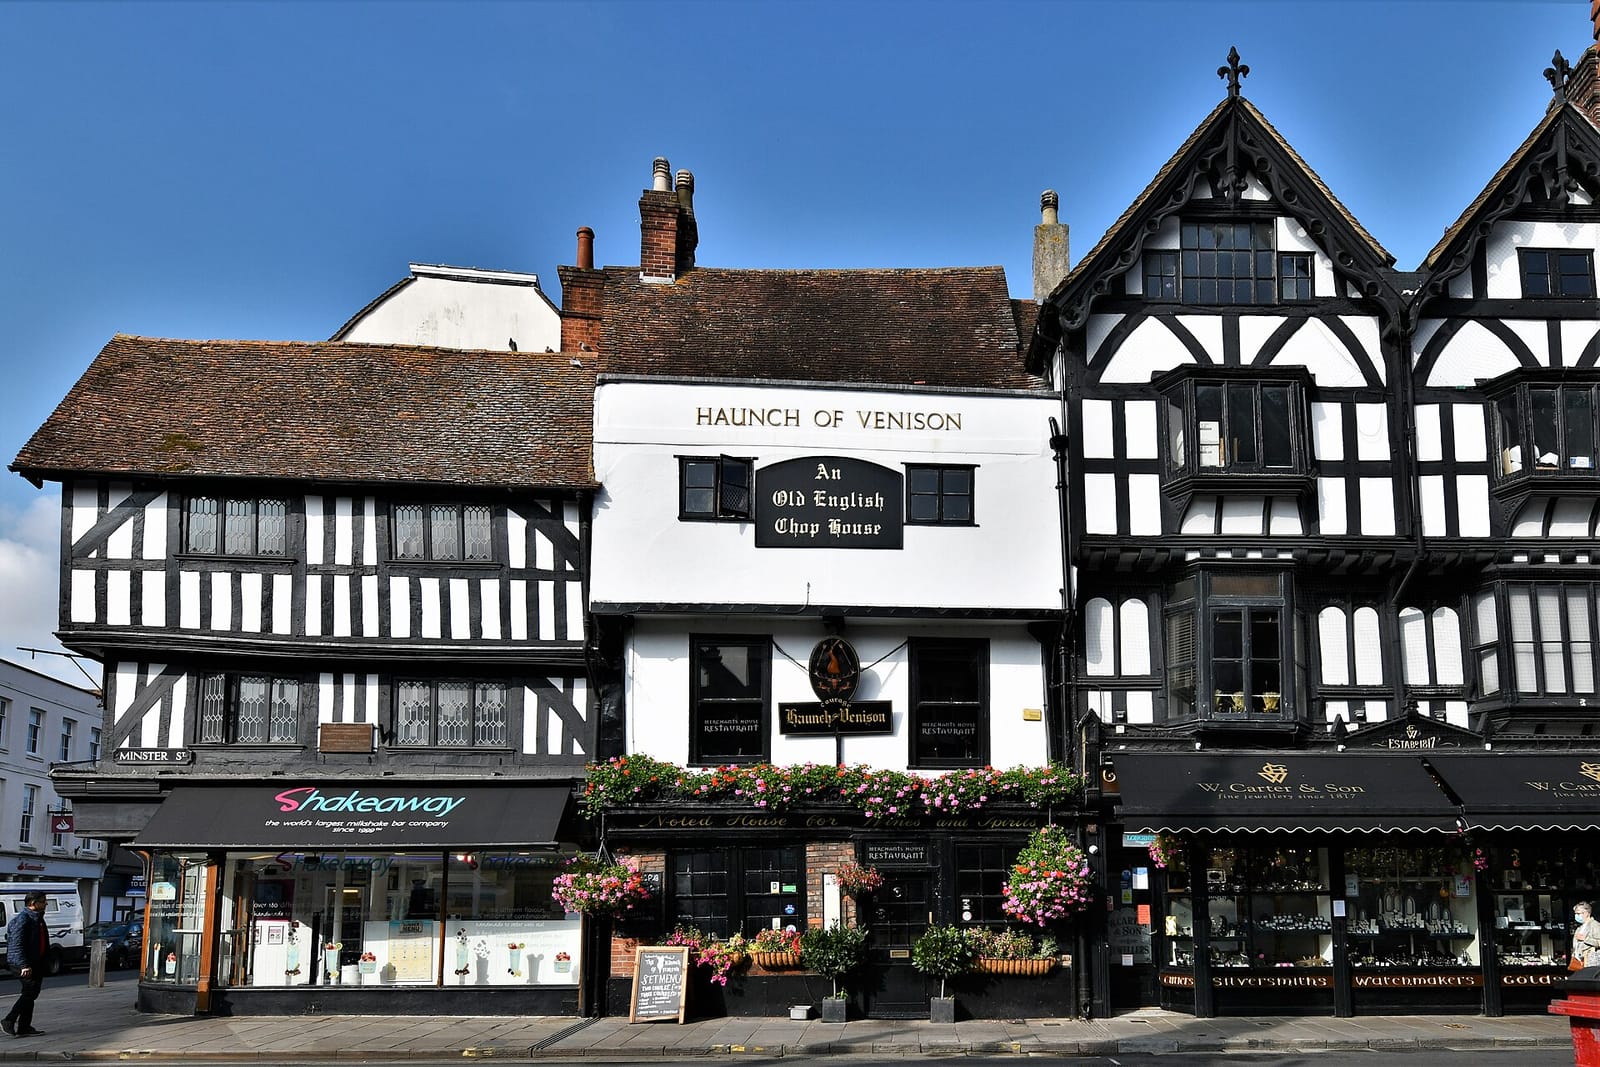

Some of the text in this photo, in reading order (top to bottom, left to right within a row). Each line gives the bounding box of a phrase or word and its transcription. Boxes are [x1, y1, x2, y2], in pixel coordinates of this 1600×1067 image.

[696, 407, 962, 431] HAUNCH OF VENISON
[814, 463, 841, 481] An
[772, 490, 885, 512] Old English
[774, 517, 882, 538] Chop House
[785, 708, 832, 727] Haunch
[839, 708, 886, 725] Venison
[704, 724, 759, 733] RESTAURANT
[1420, 737, 1436, 749] 1817
[119, 751, 168, 760] MINSTER
[1197, 783, 1366, 793] W. Carter & Son
[1524, 782, 1556, 790] W.
[274, 787, 466, 818] Shakeaway
[639, 814, 712, 828] Noted
[726, 814, 788, 827] House
[806, 815, 839, 827] for
[936, 818, 969, 827] and
[978, 816, 1037, 828] Spirits
[868, 852, 925, 860] RESTAURANT
[275, 851, 394, 877] Shakeaway
[1212, 976, 1328, 987] Silversmiths
[1355, 975, 1475, 987] Watchmakers
